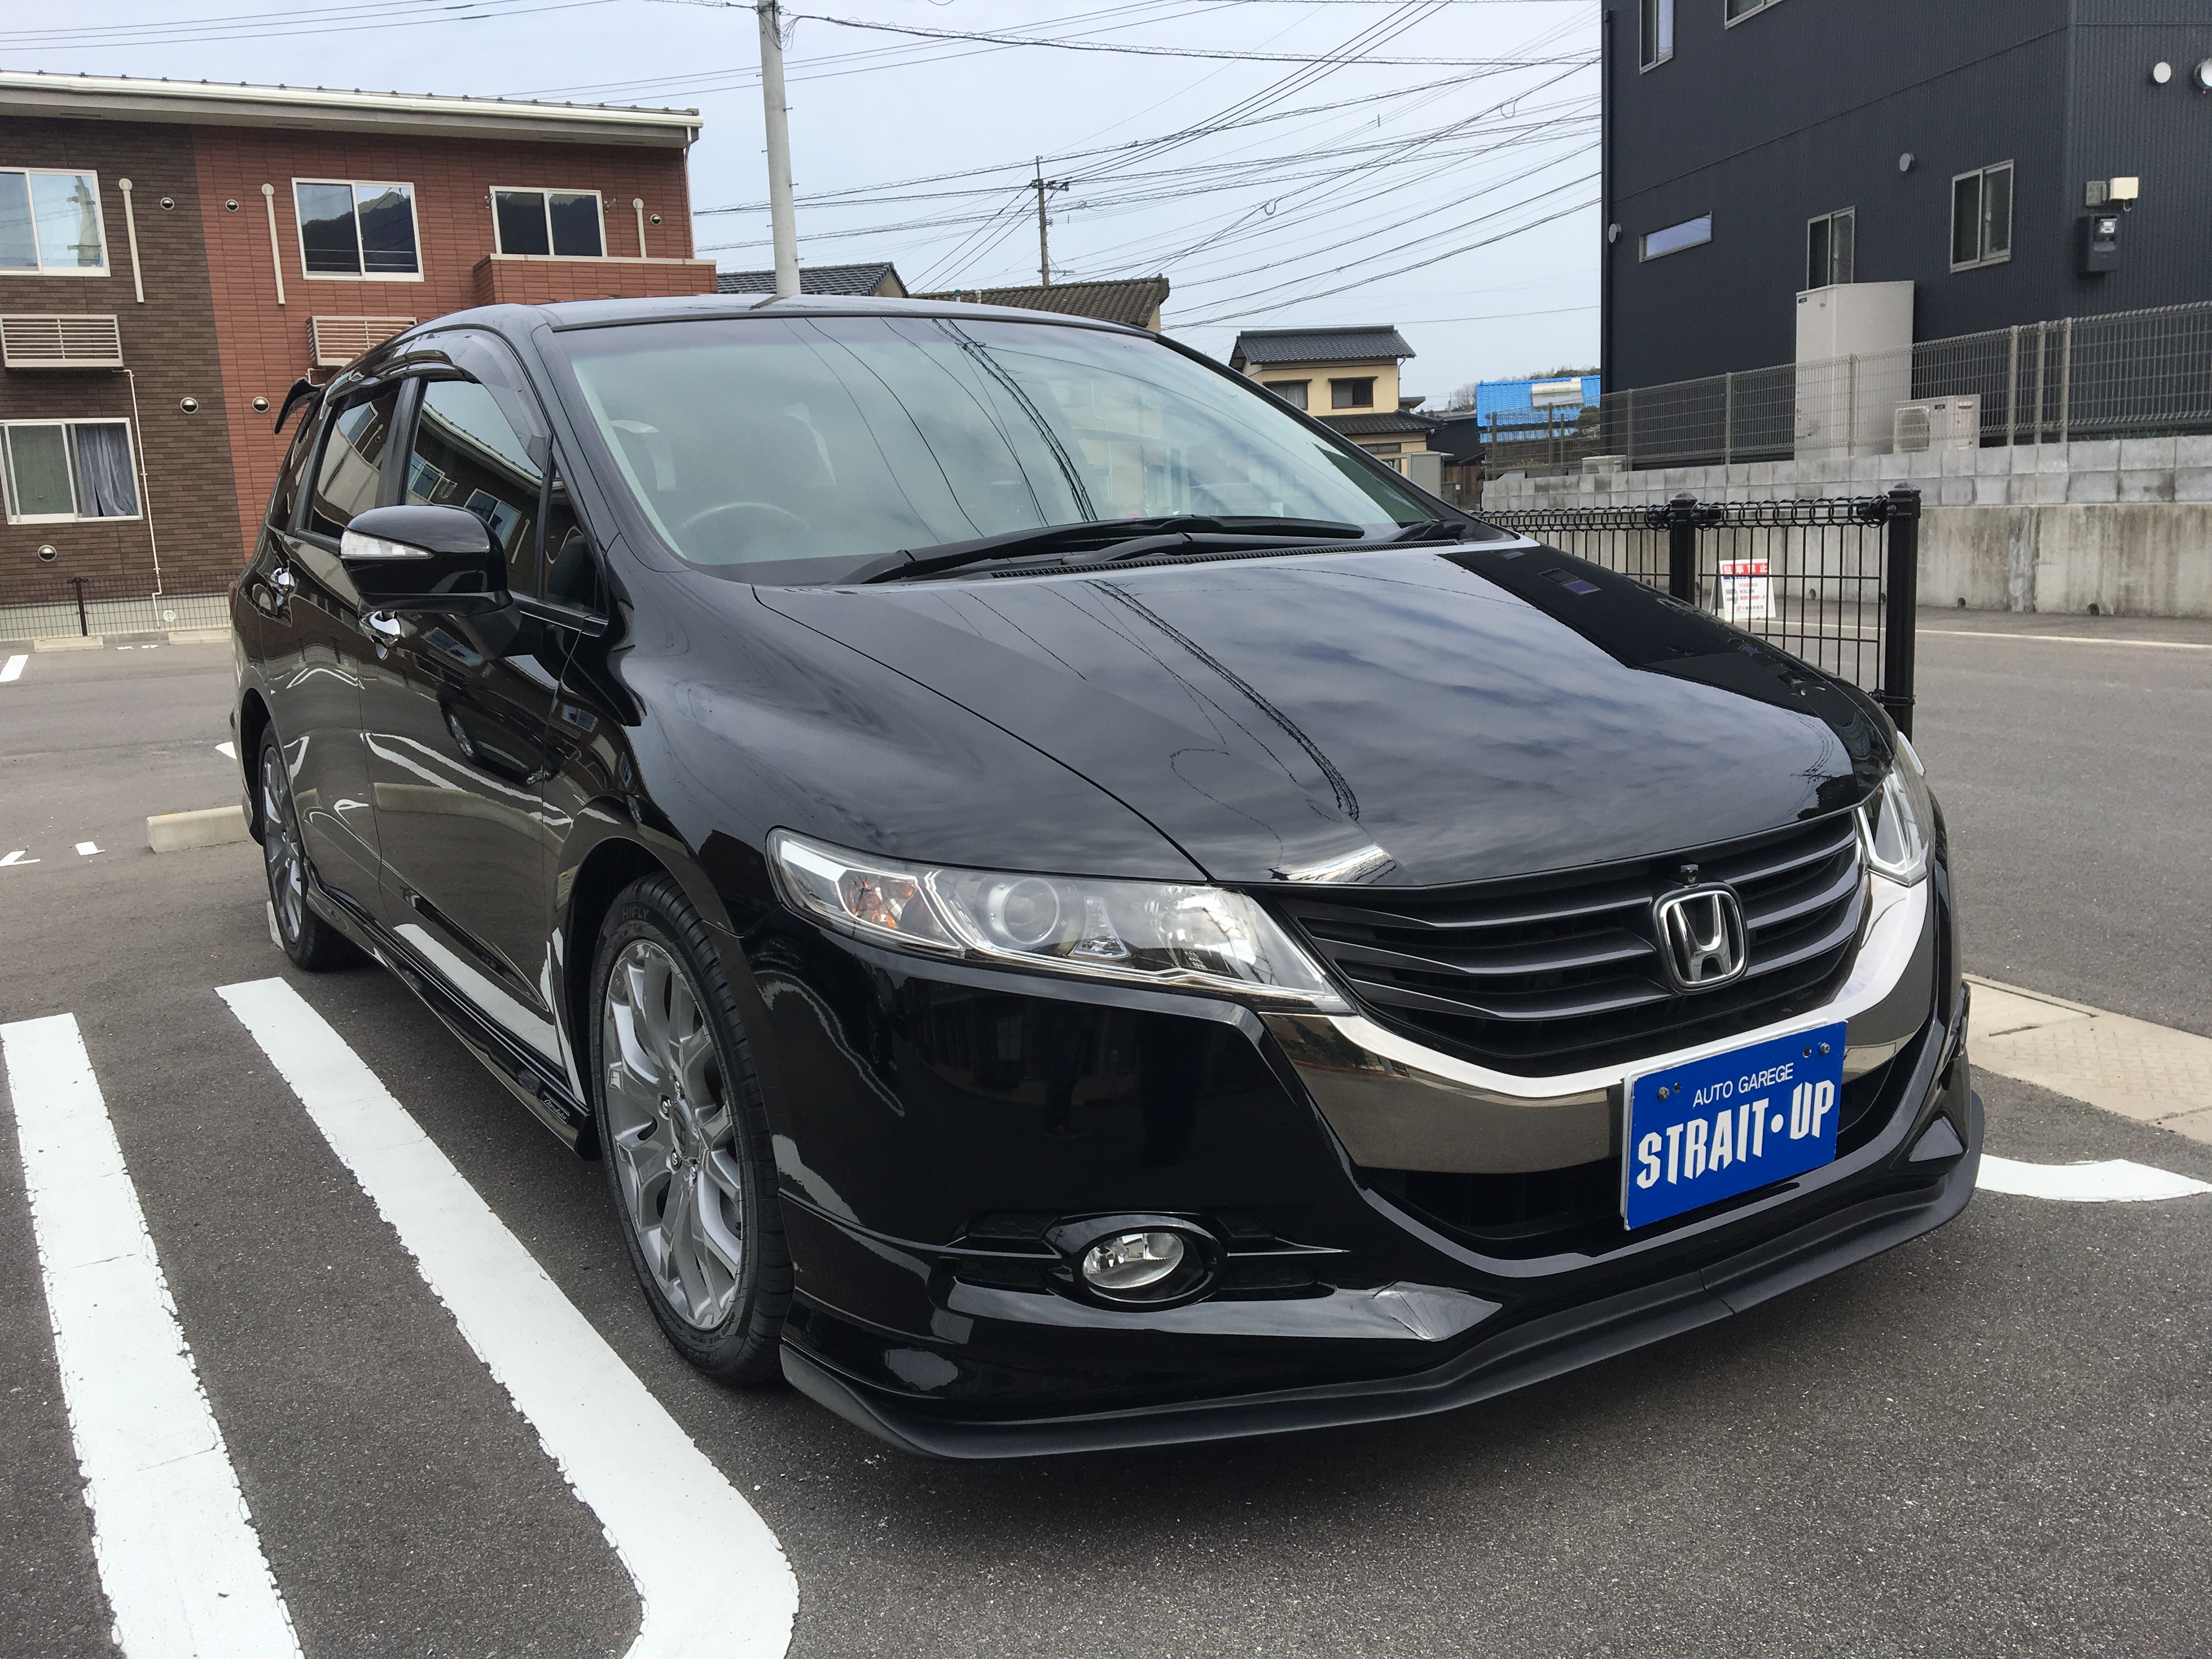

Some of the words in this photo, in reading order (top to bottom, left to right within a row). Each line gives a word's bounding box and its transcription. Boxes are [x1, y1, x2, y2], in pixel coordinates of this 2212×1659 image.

[1724, 564, 1767, 574] 駐車禁止
[622, 906, 650, 921] HIFLY
[1693, 1081, 1733, 1108] AUTO
[1739, 1062, 1794, 1093] GAREGE
